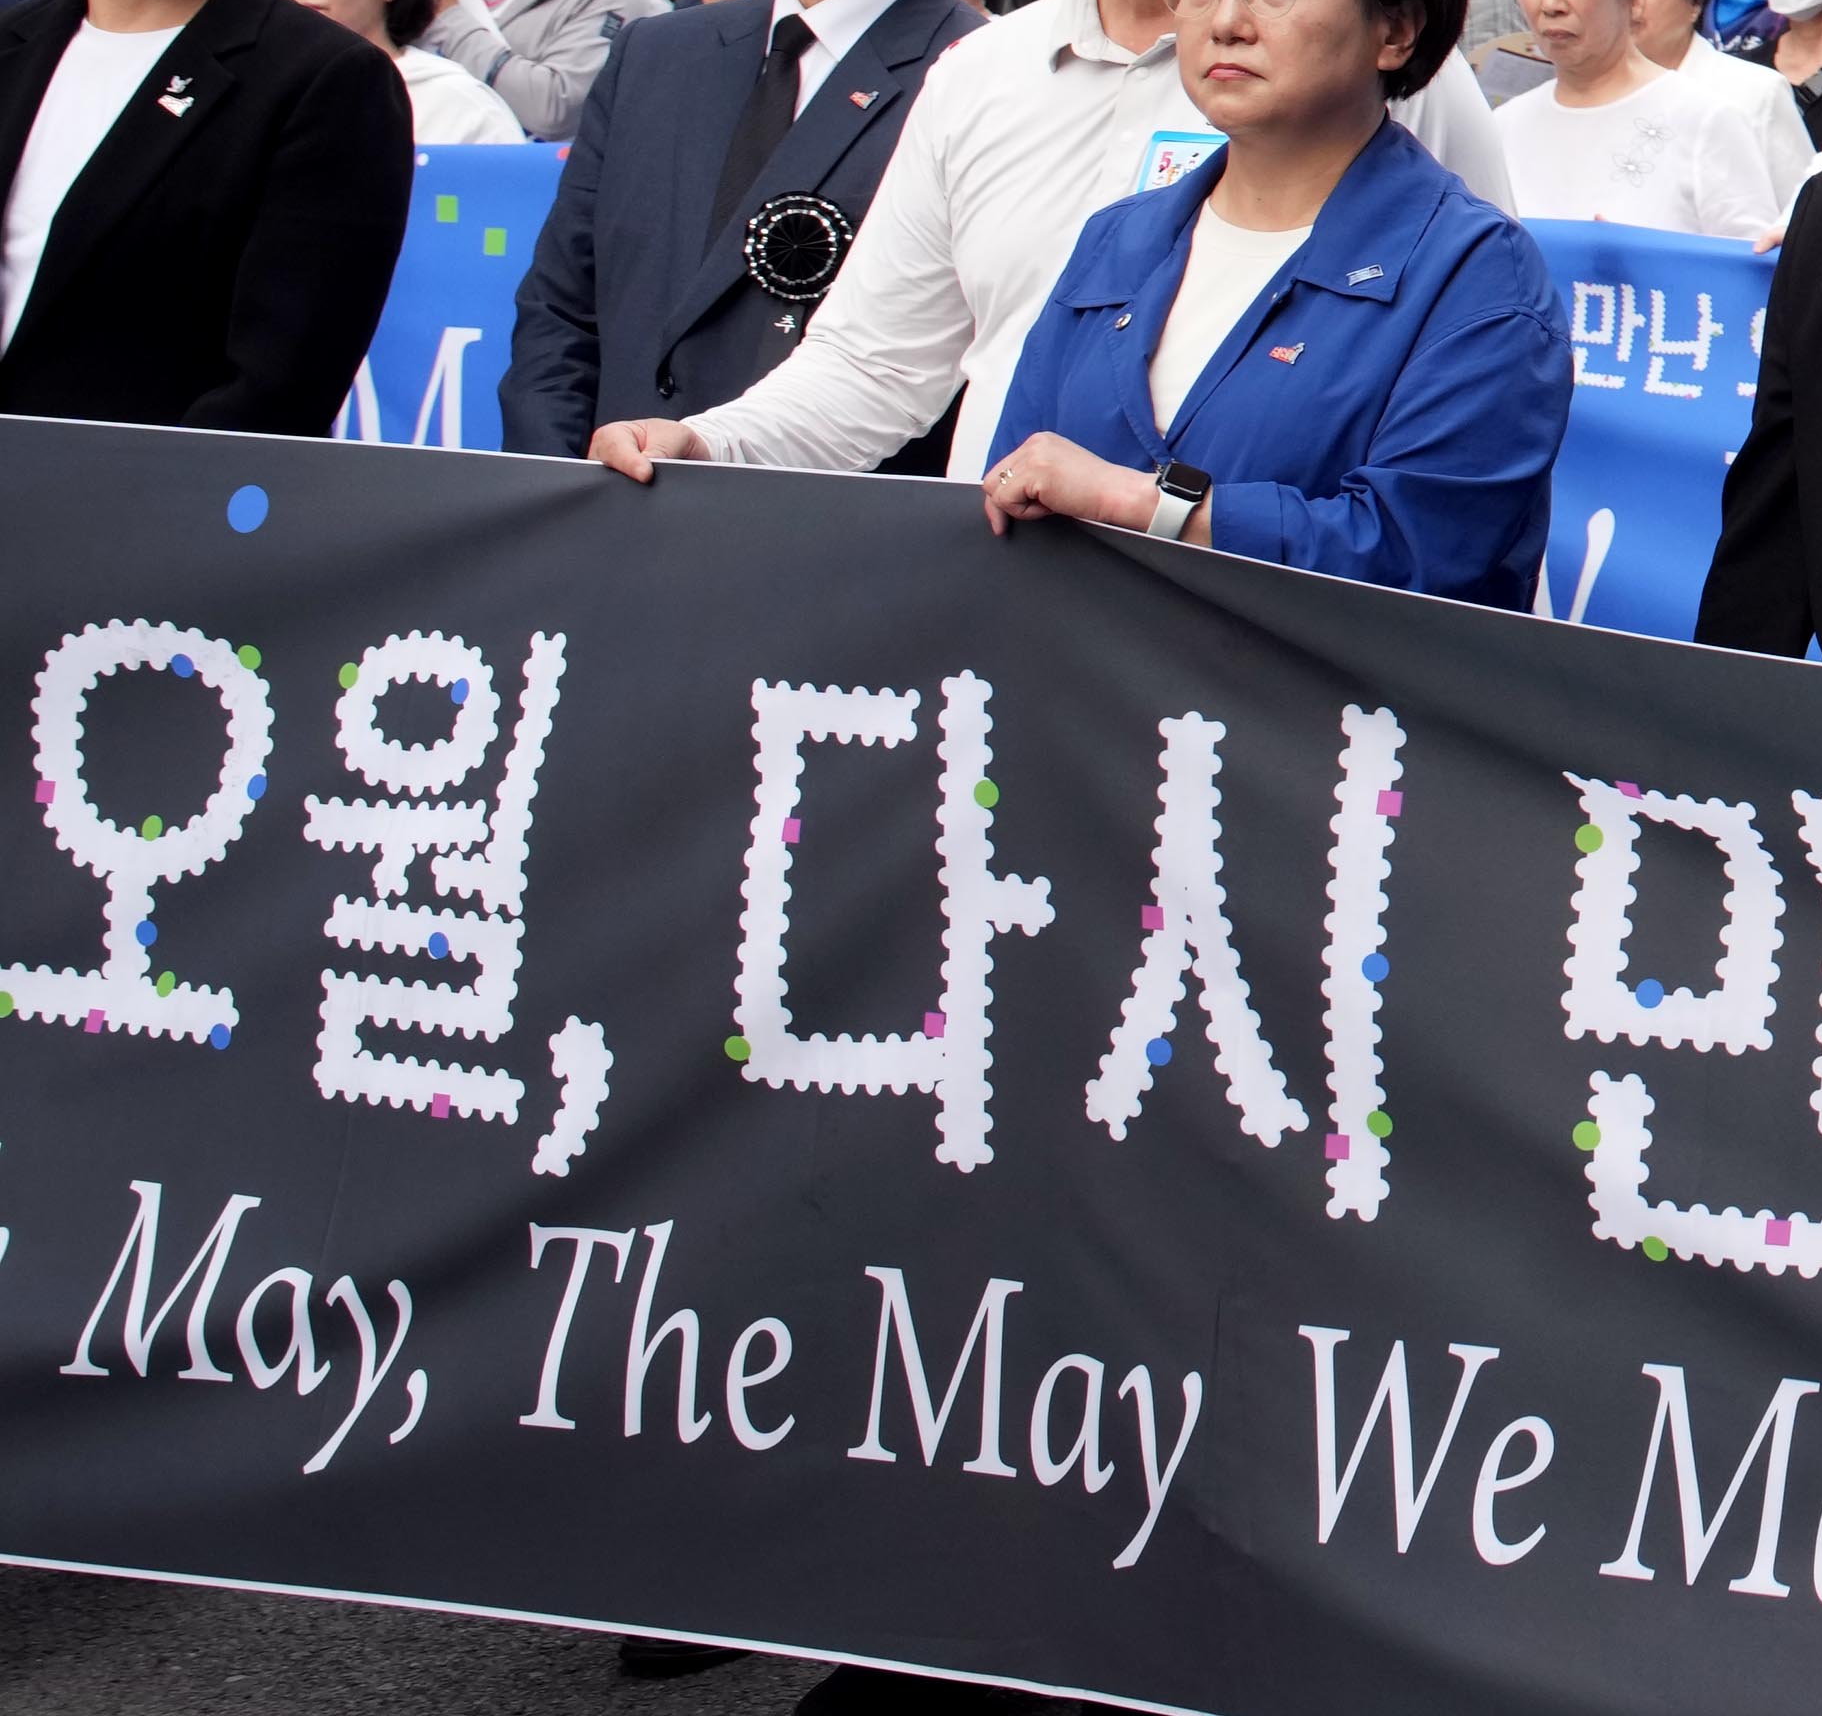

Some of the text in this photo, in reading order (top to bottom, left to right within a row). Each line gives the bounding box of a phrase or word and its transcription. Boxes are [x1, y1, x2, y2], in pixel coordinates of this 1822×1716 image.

[1571, 281, 1724, 398] 만난
[725, 670, 1408, 1223] 다시
[58, 1180, 429, 1476] May,
[517, 1219, 797, 1451] The
[846, 1266, 1204, 1571] May
[1297, 1324, 1556, 1567] We
